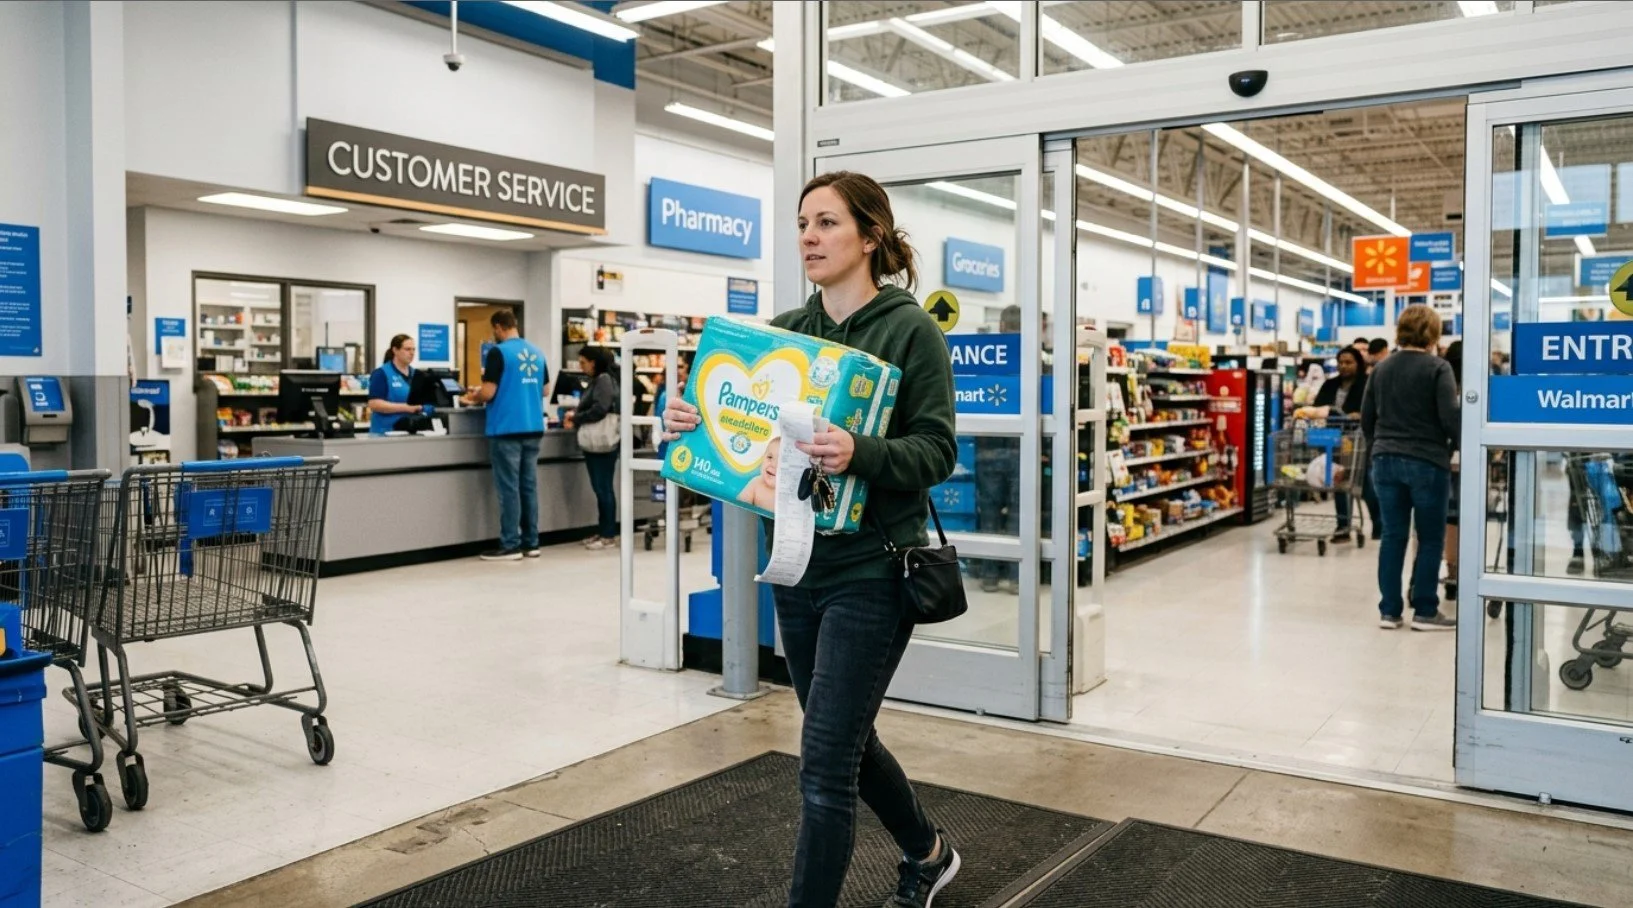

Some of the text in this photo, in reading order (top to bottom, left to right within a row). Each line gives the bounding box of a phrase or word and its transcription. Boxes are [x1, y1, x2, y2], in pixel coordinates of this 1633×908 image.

[328, 141, 595, 215] CUSTOMER SERVICE
[662, 197, 753, 245] Pharmacy
[1542, 334, 1633, 361] ENTR
[718, 380, 780, 421] Pampers
[1537, 390, 1633, 409] Walmar
